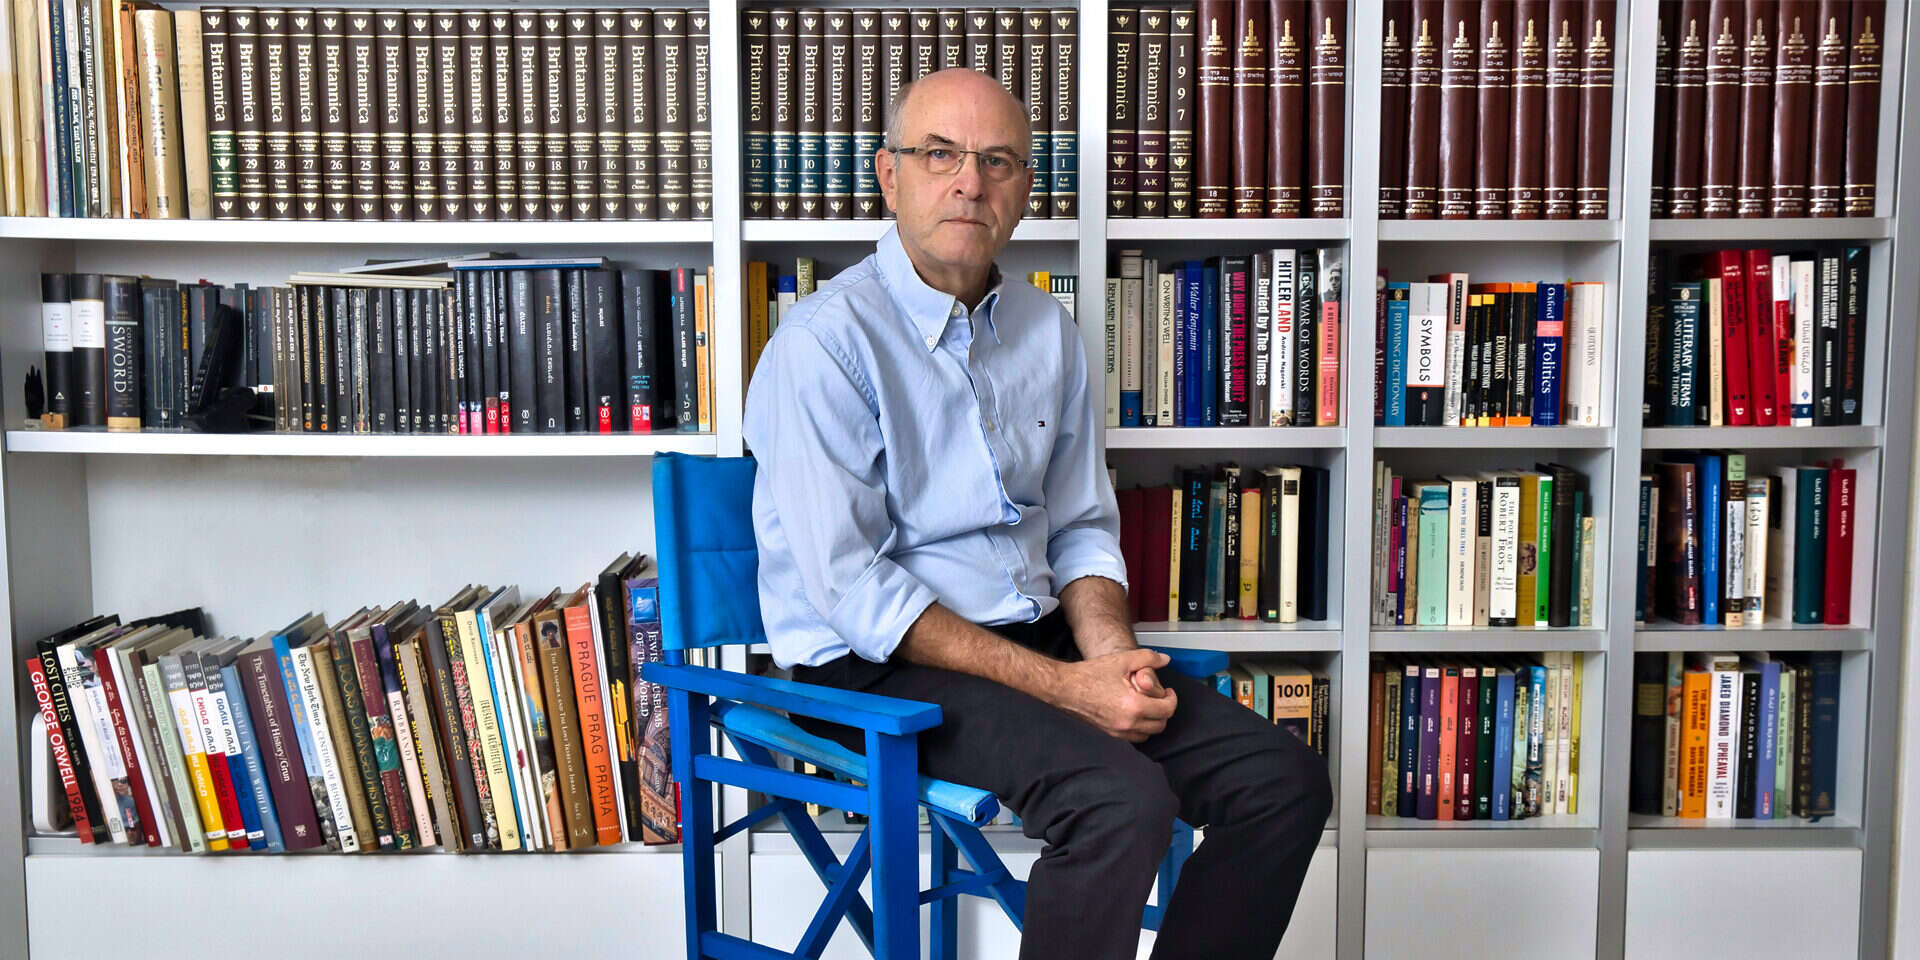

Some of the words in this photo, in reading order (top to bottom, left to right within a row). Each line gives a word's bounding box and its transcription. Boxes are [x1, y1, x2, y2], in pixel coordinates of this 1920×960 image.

[209, 42, 228, 122] Britannica
[239, 43, 257, 123] Britannica
[268, 43, 285, 123] Britannica
[297, 43, 314, 123] Britannica
[325, 44, 342, 124] Britannica
[355, 44, 372, 124] Britannica
[385, 45, 401, 125] Britannica
[415, 45, 431, 125] Britannica
[441, 45, 457, 125] Britannica
[469, 44, 485, 124] Britannica
[495, 45, 511, 124] Britannica
[520, 45, 537, 125] Britannica
[547, 45, 563, 125] Britannica
[573, 45, 589, 124] Britannica
[603, 44, 618, 124] Britannica
[631, 44, 647, 124] Britannica
[664, 44, 680, 124] Britannica
[695, 44, 710, 123] Britannica
[750, 44, 764, 122] Britannica
[777, 43, 791, 123] Britannica
[804, 44, 819, 123] Britannica
[831, 44, 846, 124] Britannica
[861, 44, 875, 123] Britannica
[1030, 44, 1044, 122] Britannica
[1058, 43, 1072, 122] Britannica
[1115, 42, 1130, 120] Britannica
[1146, 42, 1162, 121] Britannica
[71, 101, 79, 123] ישראל
[87, 98, 95, 118] ישראל
[245, 159, 258, 170] 29
[274, 159, 286, 170] 28
[302, 159, 314, 170] 27
[330, 159, 343, 170] 26
[360, 159, 372, 170] 25
[389, 159, 400, 170] 24
[419, 159, 430, 170] 23
[445, 159, 457, 170] 22
[473, 159, 484, 170] 21
[498, 159, 511, 170] 20
[525, 159, 536, 170] 19
[551, 159, 562, 170] 18
[577, 159, 588, 170] 17
[606, 159, 616, 170] 16
[635, 159, 646, 170] 15
[667, 159, 678, 170] 14
[697, 159, 708, 170] 13
[751, 159, 761, 169] 12
[778, 159, 787, 169] 11
[804, 159, 815, 169] 10
[833, 159, 841, 169] 9
[863, 159, 870, 169] 8
[1061, 158, 1066, 168] 1
[1113, 177, 1127, 185] L-Z
[1143, 178, 1158, 187] A-K
[1162, 280, 1170, 294] ON
[1190, 282, 1200, 309] Walter
[1232, 272, 1245, 292] WHY
[1258, 278, 1270, 313] Buried
[1277, 261, 1292, 333] HITLERLAND
[1830, 286, 1838, 301] LAST
[1107, 283, 1117, 320] BENJAMIN
[1162, 295, 1170, 326] WRITING
[1232, 294, 1245, 321] DIDN'T
[1300, 299, 1310, 325] WAR
[1546, 287, 1556, 319] Oxford
[1822, 286, 1830, 328] INTELLIGENCE
[1162, 327, 1170, 344] WELL
[1187, 312, 1200, 350] Benjamin
[1232, 323, 1245, 339] THE
[1256, 317, 1269, 329] by
[1300, 329, 1310, 345] OF
[1392, 312, 1402, 357] RHYMING
[1105, 324, 1116, 374] REFLECTIONS
[1232, 341, 1245, 367] PRESS
[1257, 332, 1269, 351] The
[1419, 319, 1432, 382] SYMBOLS
[1471, 344, 1479, 360] WORLD
[1482, 342, 1491, 363] WORLD
[1494, 336, 1506, 379] ECONOMICS
[1517, 343, 1526, 369] MODERN
[1672, 338, 1680, 373] LITERARY
[1681, 318, 1695, 368] LITERARY
[112, 326, 126, 393] SWORD
[1256, 354, 1268, 386] Times
[1300, 348, 1310, 392] WORDS
[1541, 342, 1556, 394] Politics
[1801, 346, 1810, 374] המילים
[1391, 359, 1400, 416] DICTIONARY
[1481, 364, 1491, 389] HISTORY
[1516, 370, 1525, 396] HISTORY
[1671, 376, 1679, 406] THEORY
[1680, 371, 1691, 407] TERMS
[1498, 492, 1509, 533] ROBERT
[1497, 539, 1507, 573] FROST
[1507, 554, 1512, 563] OF
[636, 632, 644, 646] OF
[647, 631, 659, 663] JEWIS
[298, 653, 307, 668] The
[302, 668, 310, 684] New
[41, 650, 60, 680] LOST
[52, 683, 72, 723] CITIES
[304, 683, 317, 704] York
[1277, 684, 1310, 697] 1001
[1720, 674, 1731, 698] JARED
[197, 697, 209, 725] נאומים
[205, 727, 216, 752] ששינו
[216, 698, 229, 726] מסעות
[224, 728, 236, 753] ששינו
[253, 656, 262, 672] The
[258, 674, 275, 718] Timetables
[272, 726, 290, 782] History/Grun
[311, 703, 321, 726] Times
[393, 700, 412, 761] REMBRANDT
[577, 641, 596, 704] PRAGUE
[587, 714, 603, 754] PRAG
[595, 765, 613, 816] PRAHA
[1718, 701, 1730, 737] DIAMOND
[1748, 681, 1757, 759] ANTI-JUDAISM
[31, 671, 58, 730] GEORGE
[50, 734, 76, 789] ORWELL
[68, 792, 85, 822] 1984
[233, 702, 248, 735] ISRAEL
[248, 756, 256, 772] THE
[254, 778, 268, 814] WORLD
[338, 664, 357, 709] BOOKS
[351, 717, 373, 783] CHANGED
[367, 782, 384, 830] HISTORY
[1717, 742, 1728, 779] UPHEAVAL
[317, 731, 333, 768] CENTURY
[329, 783, 345, 820] BUSINESS
